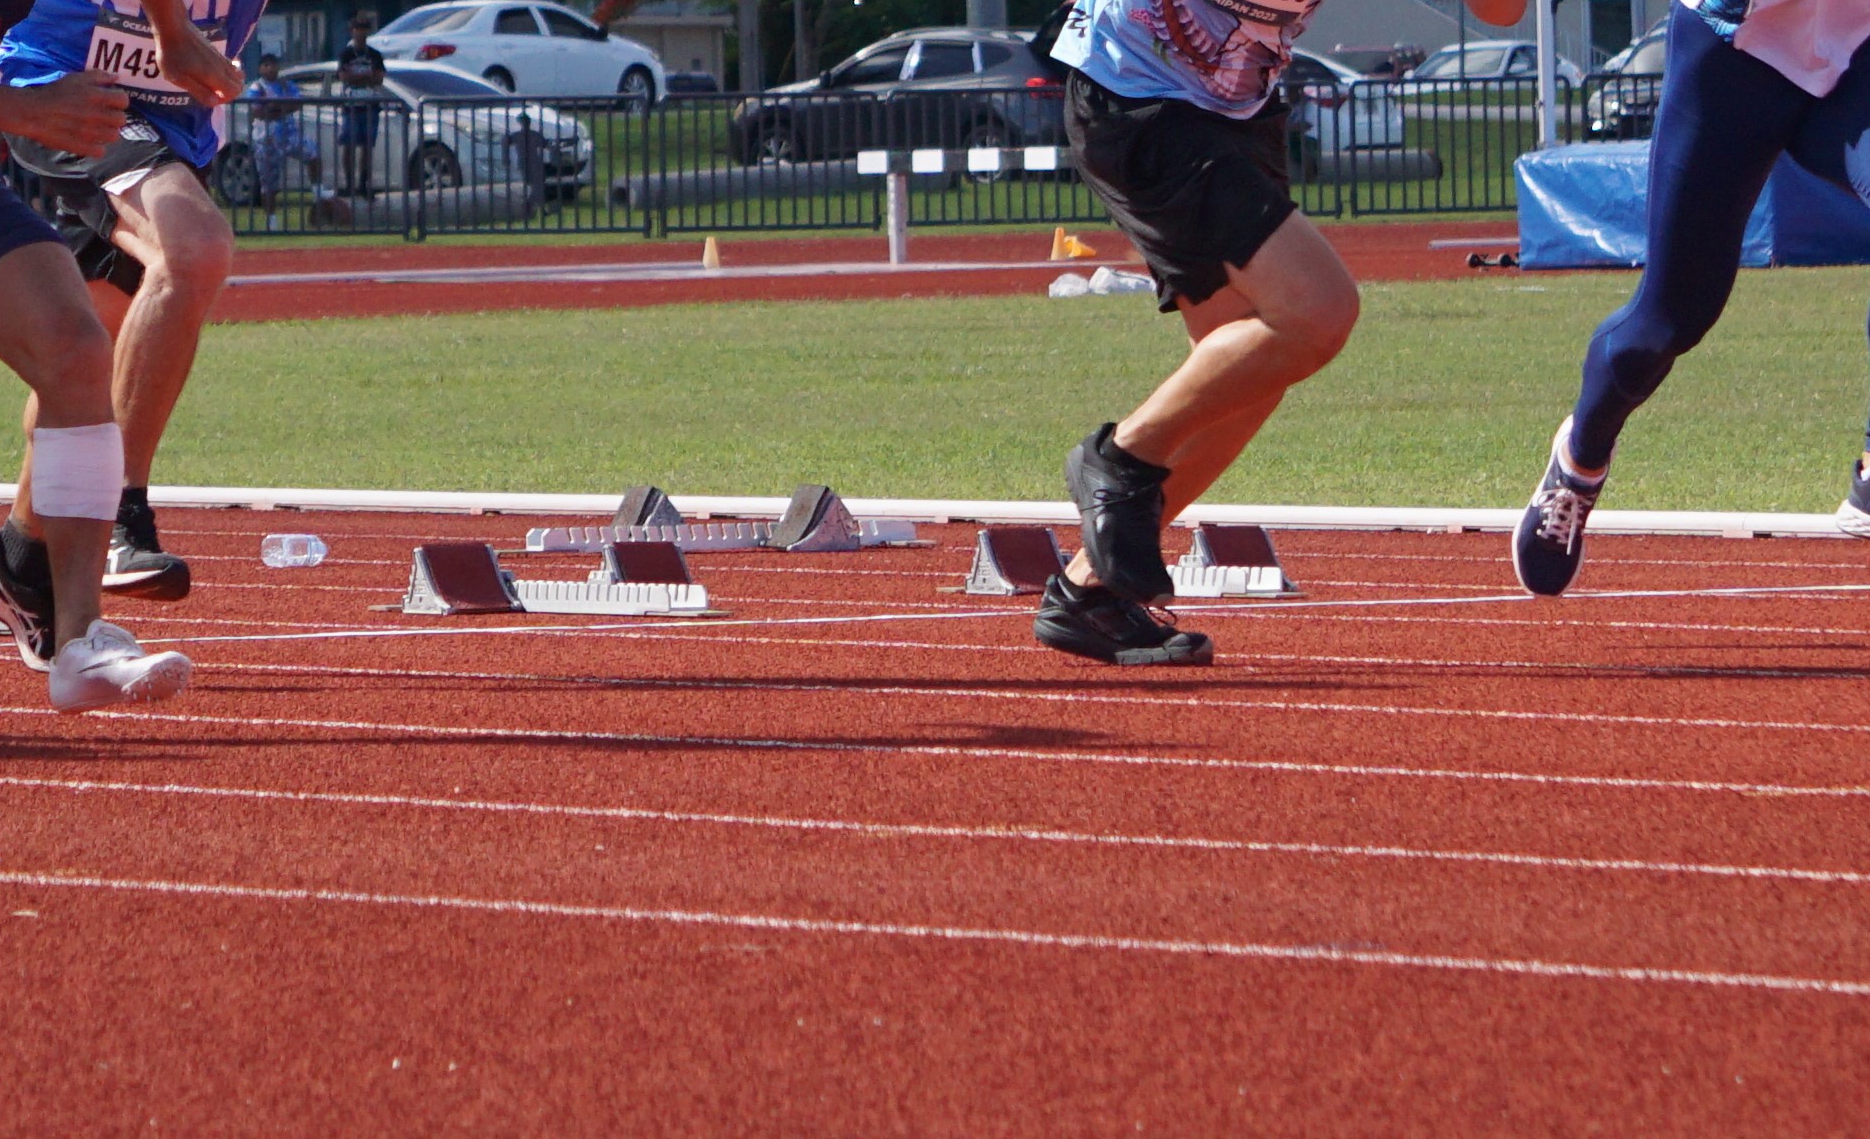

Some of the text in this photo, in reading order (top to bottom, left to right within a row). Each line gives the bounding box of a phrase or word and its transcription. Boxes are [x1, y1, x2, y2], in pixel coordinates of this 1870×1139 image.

[1249, 8, 1277, 22] 2023
[122, 20, 153, 33] OCEAN
[92, 39, 161, 79] M45
[159, 96, 189, 106] 2023
